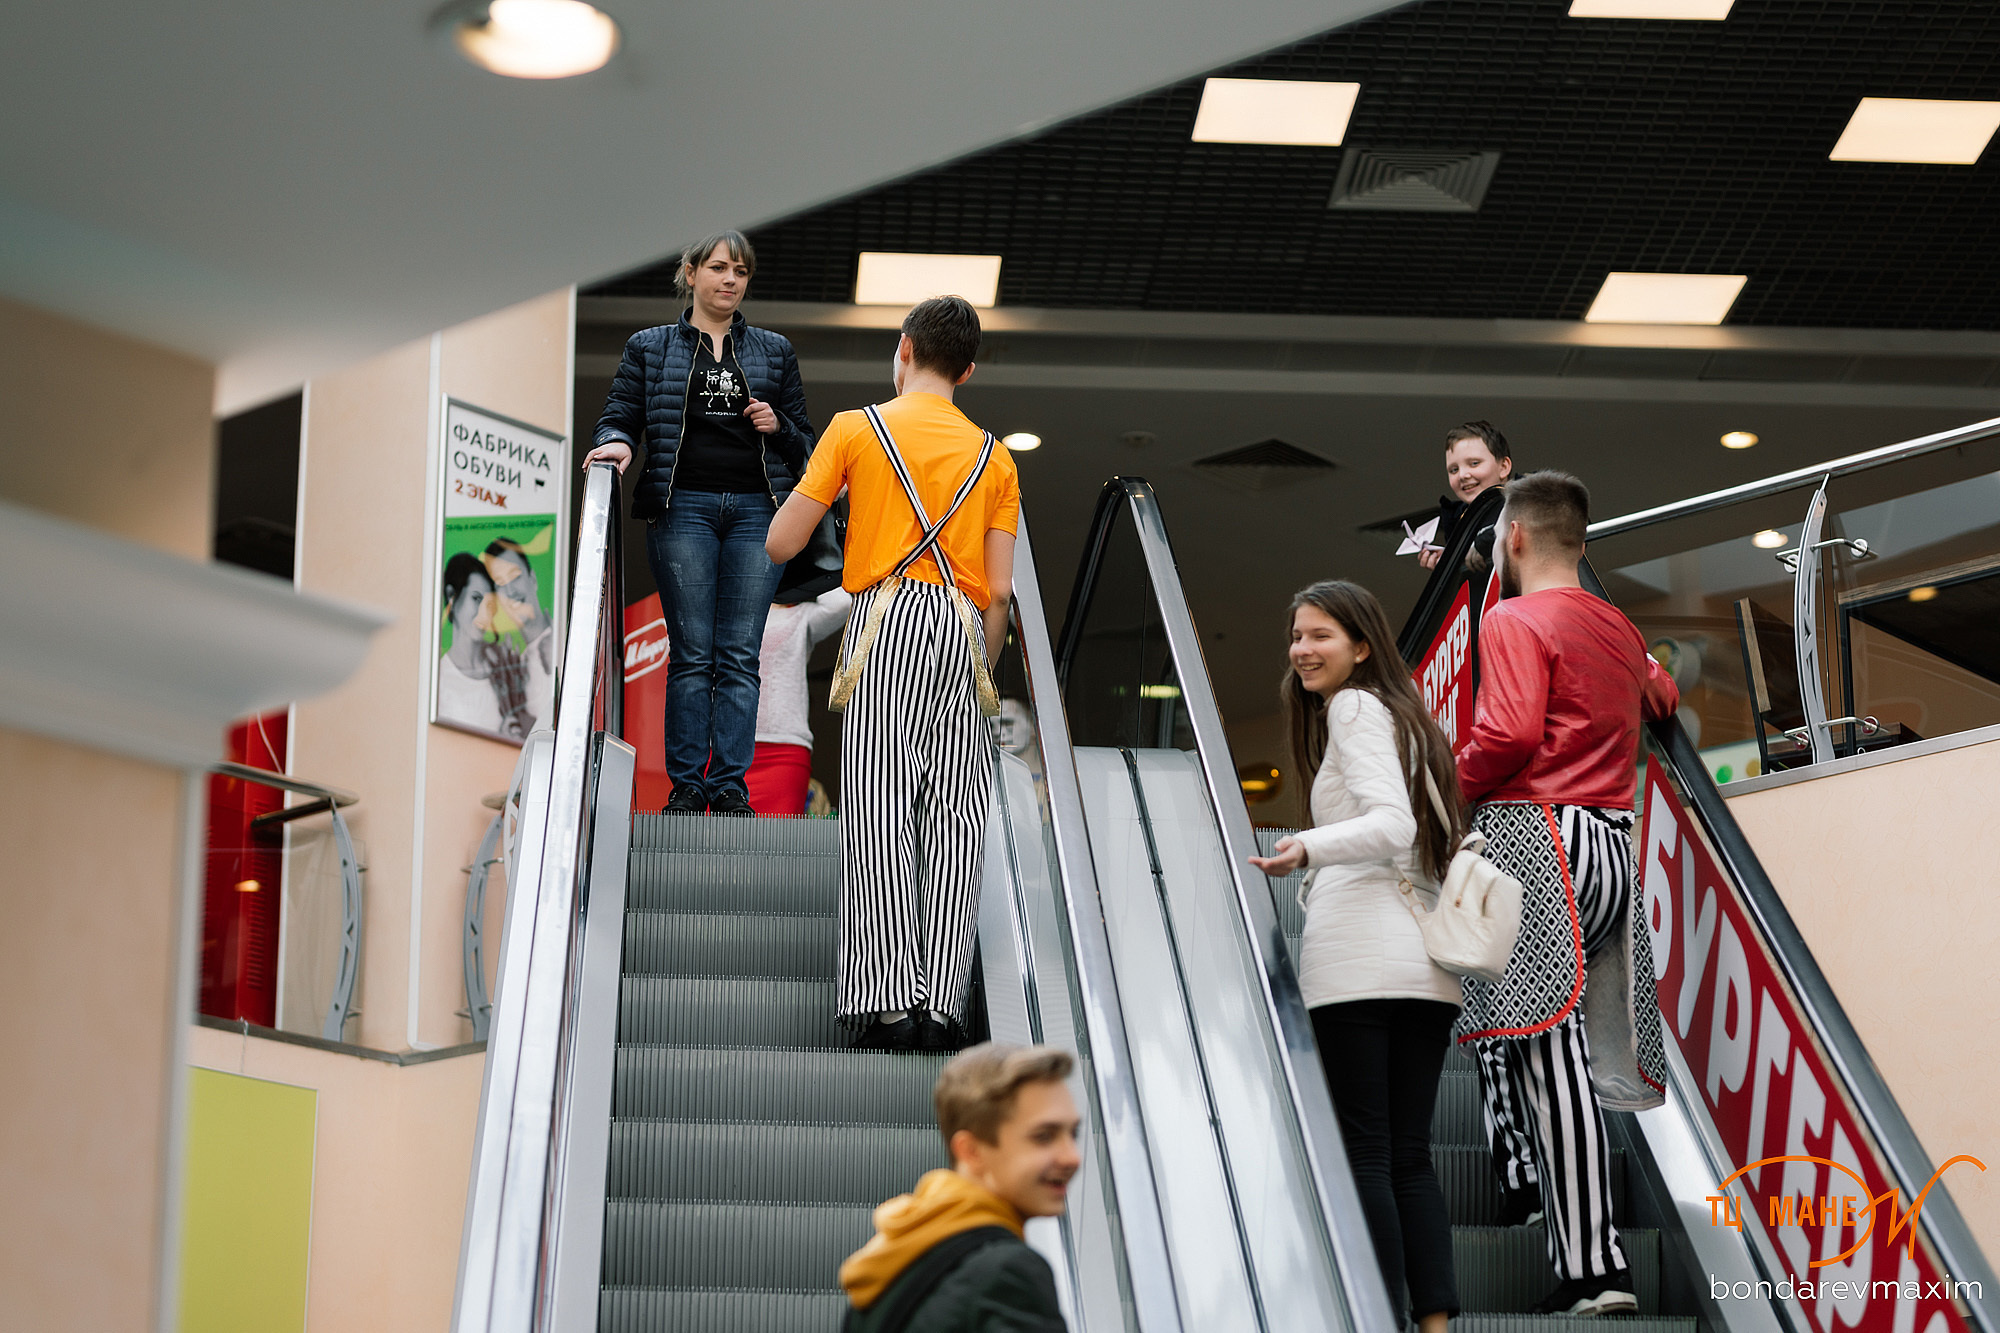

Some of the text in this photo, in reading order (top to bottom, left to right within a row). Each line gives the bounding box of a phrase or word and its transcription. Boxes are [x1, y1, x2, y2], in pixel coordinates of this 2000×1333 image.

[453, 423, 551, 471] ФАБРИКА
[453, 450, 522, 488] ОБУВИ
[455, 479, 507, 508] 2 ЭТАЖ
[1423, 604, 1469, 715] БУРГЕР
[1643, 780, 1874, 1333] БУРГЕР
